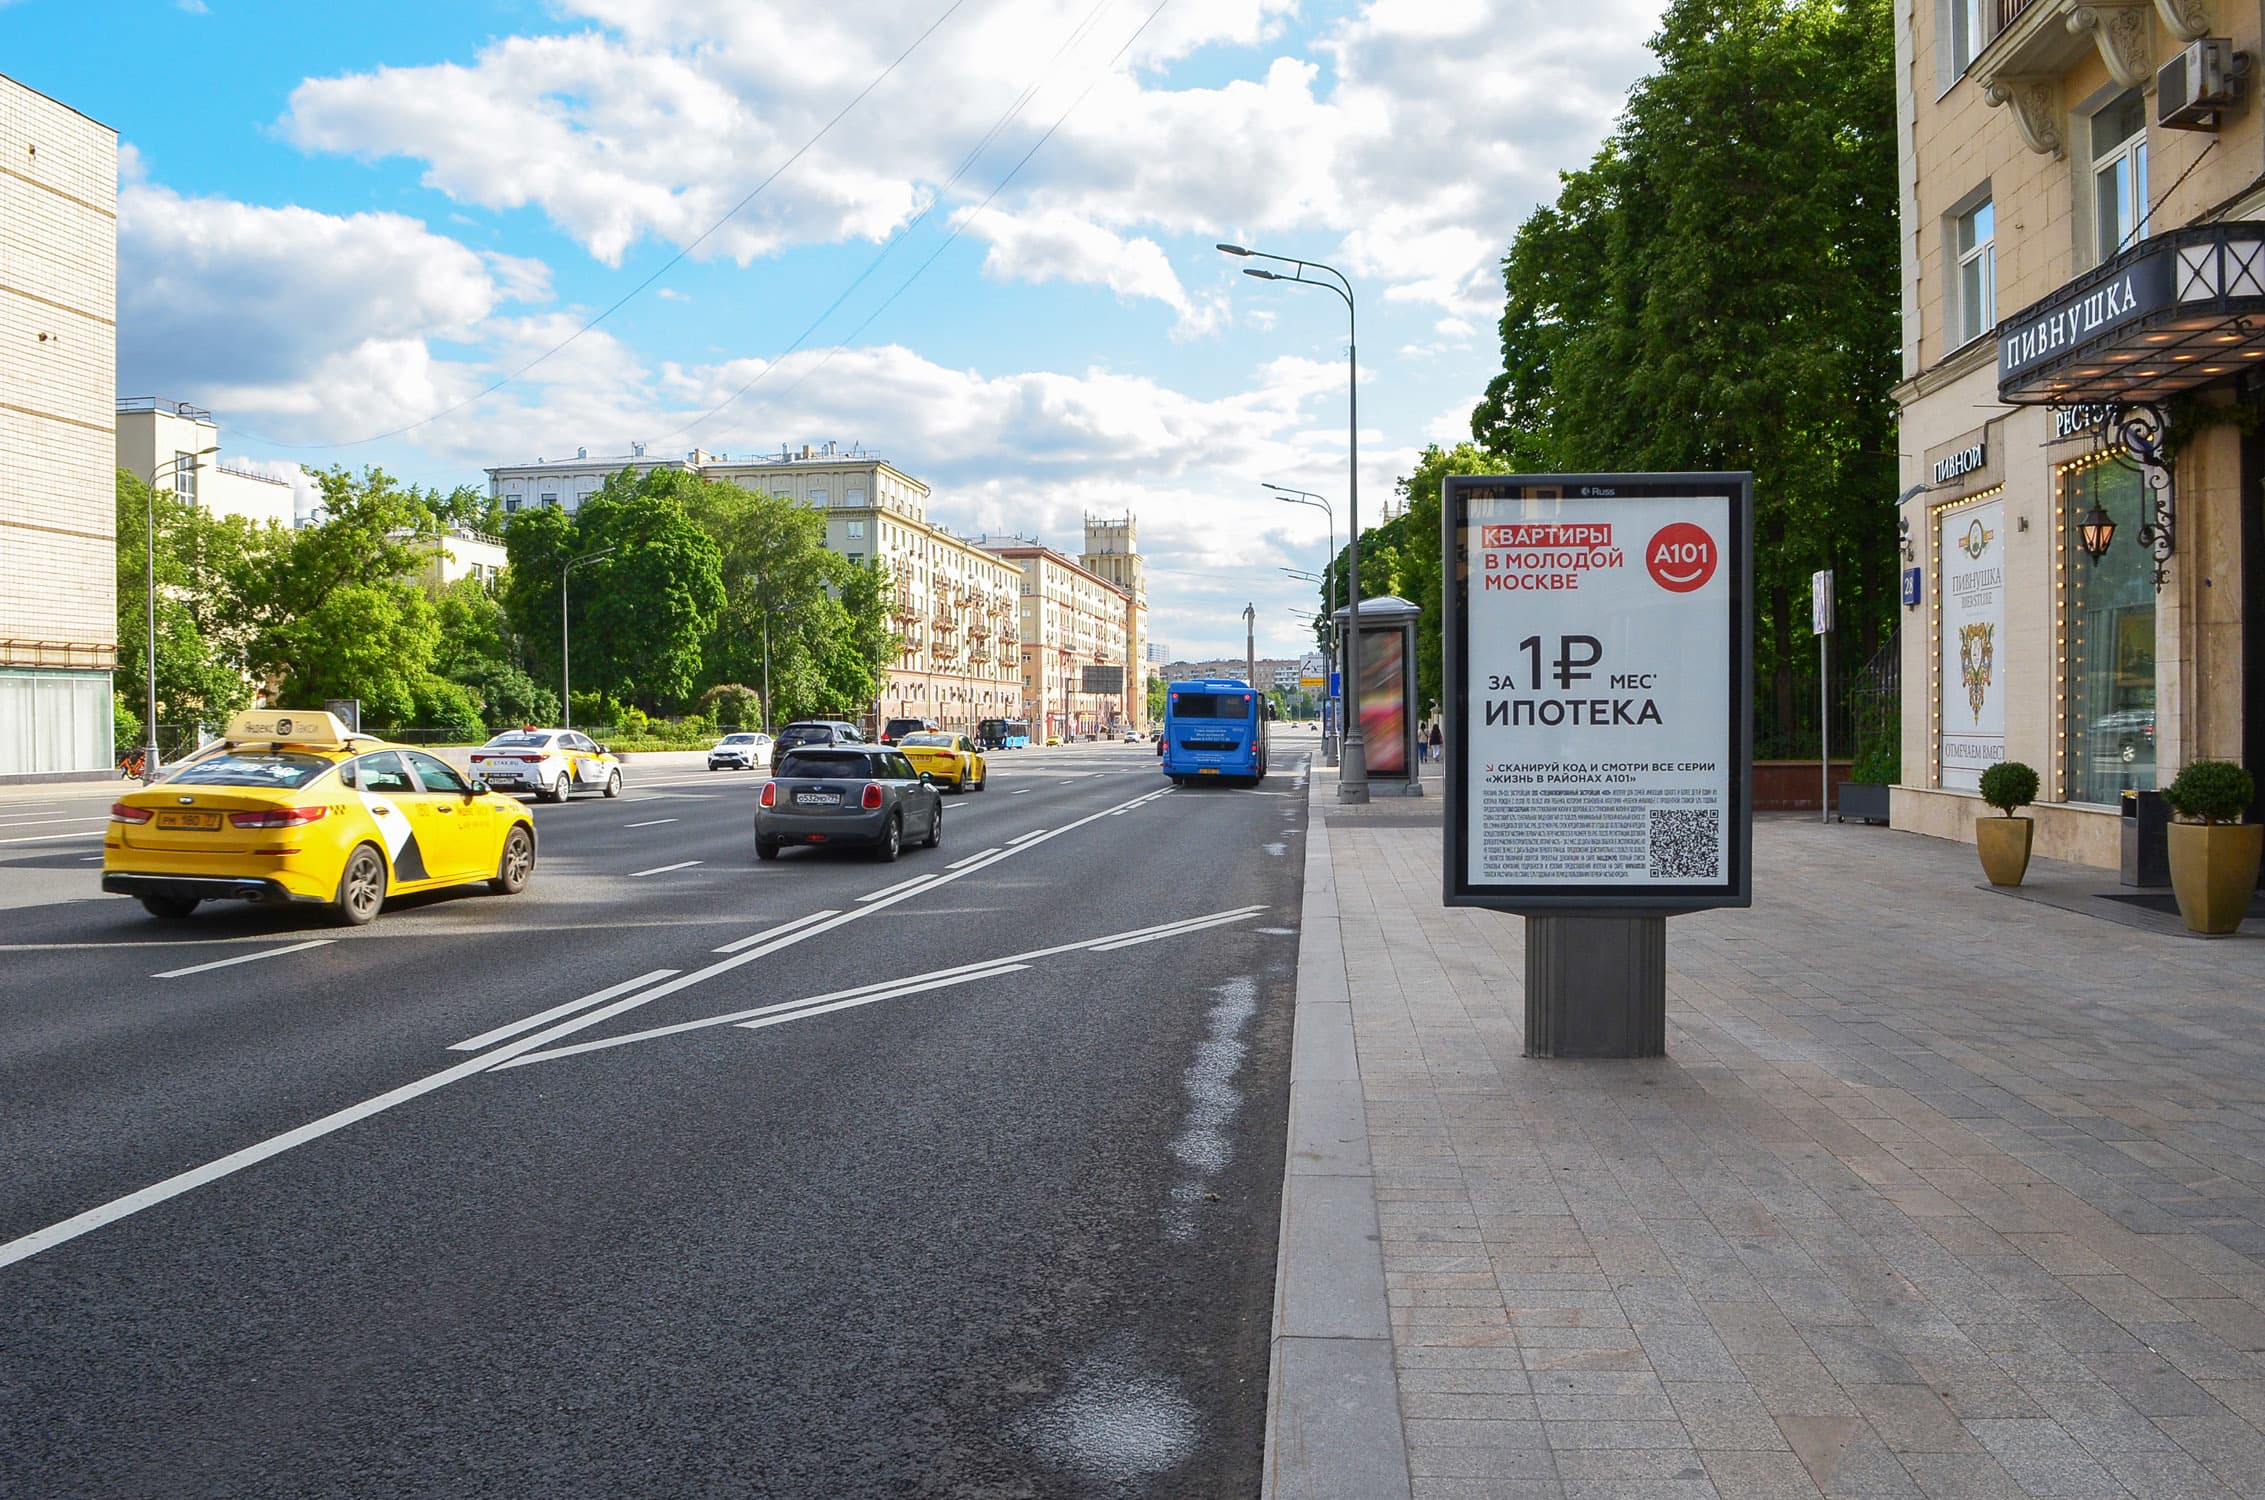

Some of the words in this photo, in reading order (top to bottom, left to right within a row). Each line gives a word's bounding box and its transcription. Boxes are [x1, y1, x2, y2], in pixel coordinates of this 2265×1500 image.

[2007, 274, 2136, 369] ПИВНУШКА
[1933, 444, 1982, 483] ПИВНОЙ
[1591, 487, 1616, 496] Russ
[1485, 526, 1609, 546] КВАРТИРЫ
[1485, 553, 1499, 569] В
[1506, 547, 1623, 571] МОЛОДОЙ
[1654, 543, 1708, 564] А101
[1485, 573, 1578, 590] МОСКВЕ
[1904, 576, 1914, 595] 28
[1952, 567, 2001, 592] ПИВНУШКА
[1488, 675, 1515, 690] ЗА
[1485, 699, 1663, 726] ИПОТЕКА
[1945, 743, 1982, 759] ОТМЕЧАЕМ
[1498, 762, 1559, 772] СКАНИРУЙ
[1563, 763, 1587, 773] КОД
[1590, 763, 1598, 772] И
[1602, 763, 1648, 771] СМОТРИ
[1652, 763, 1674, 771] ВСЕ
[1677, 763, 1715, 771] СЕРИИ
[1486, 775, 1533, 783] «ЖИЗНЬ
[1537, 775, 1544, 783] В
[1547, 773, 1602, 783] РАЙОНАХ
